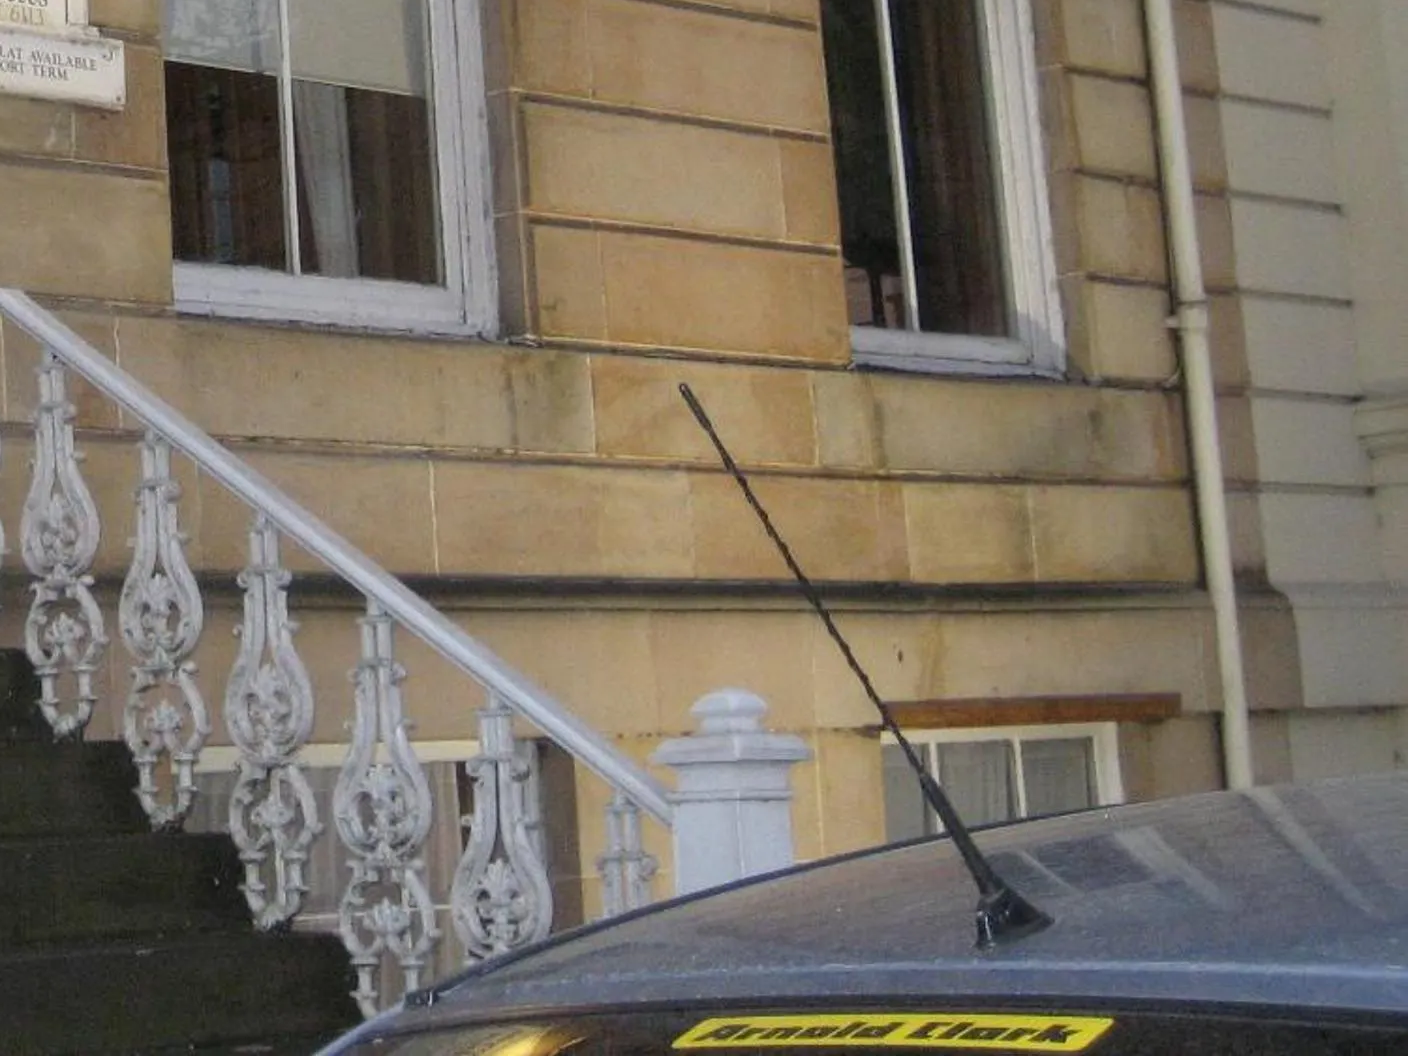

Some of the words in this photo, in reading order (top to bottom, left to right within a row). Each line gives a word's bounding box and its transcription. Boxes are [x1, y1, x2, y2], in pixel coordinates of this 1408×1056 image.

[30, 48, 98, 72] AVAILABLE
[32, 64, 70, 82] TERM
[693, 1021, 906, 1041] Arnold
[905, 1021, 1083, 1044] Clark
